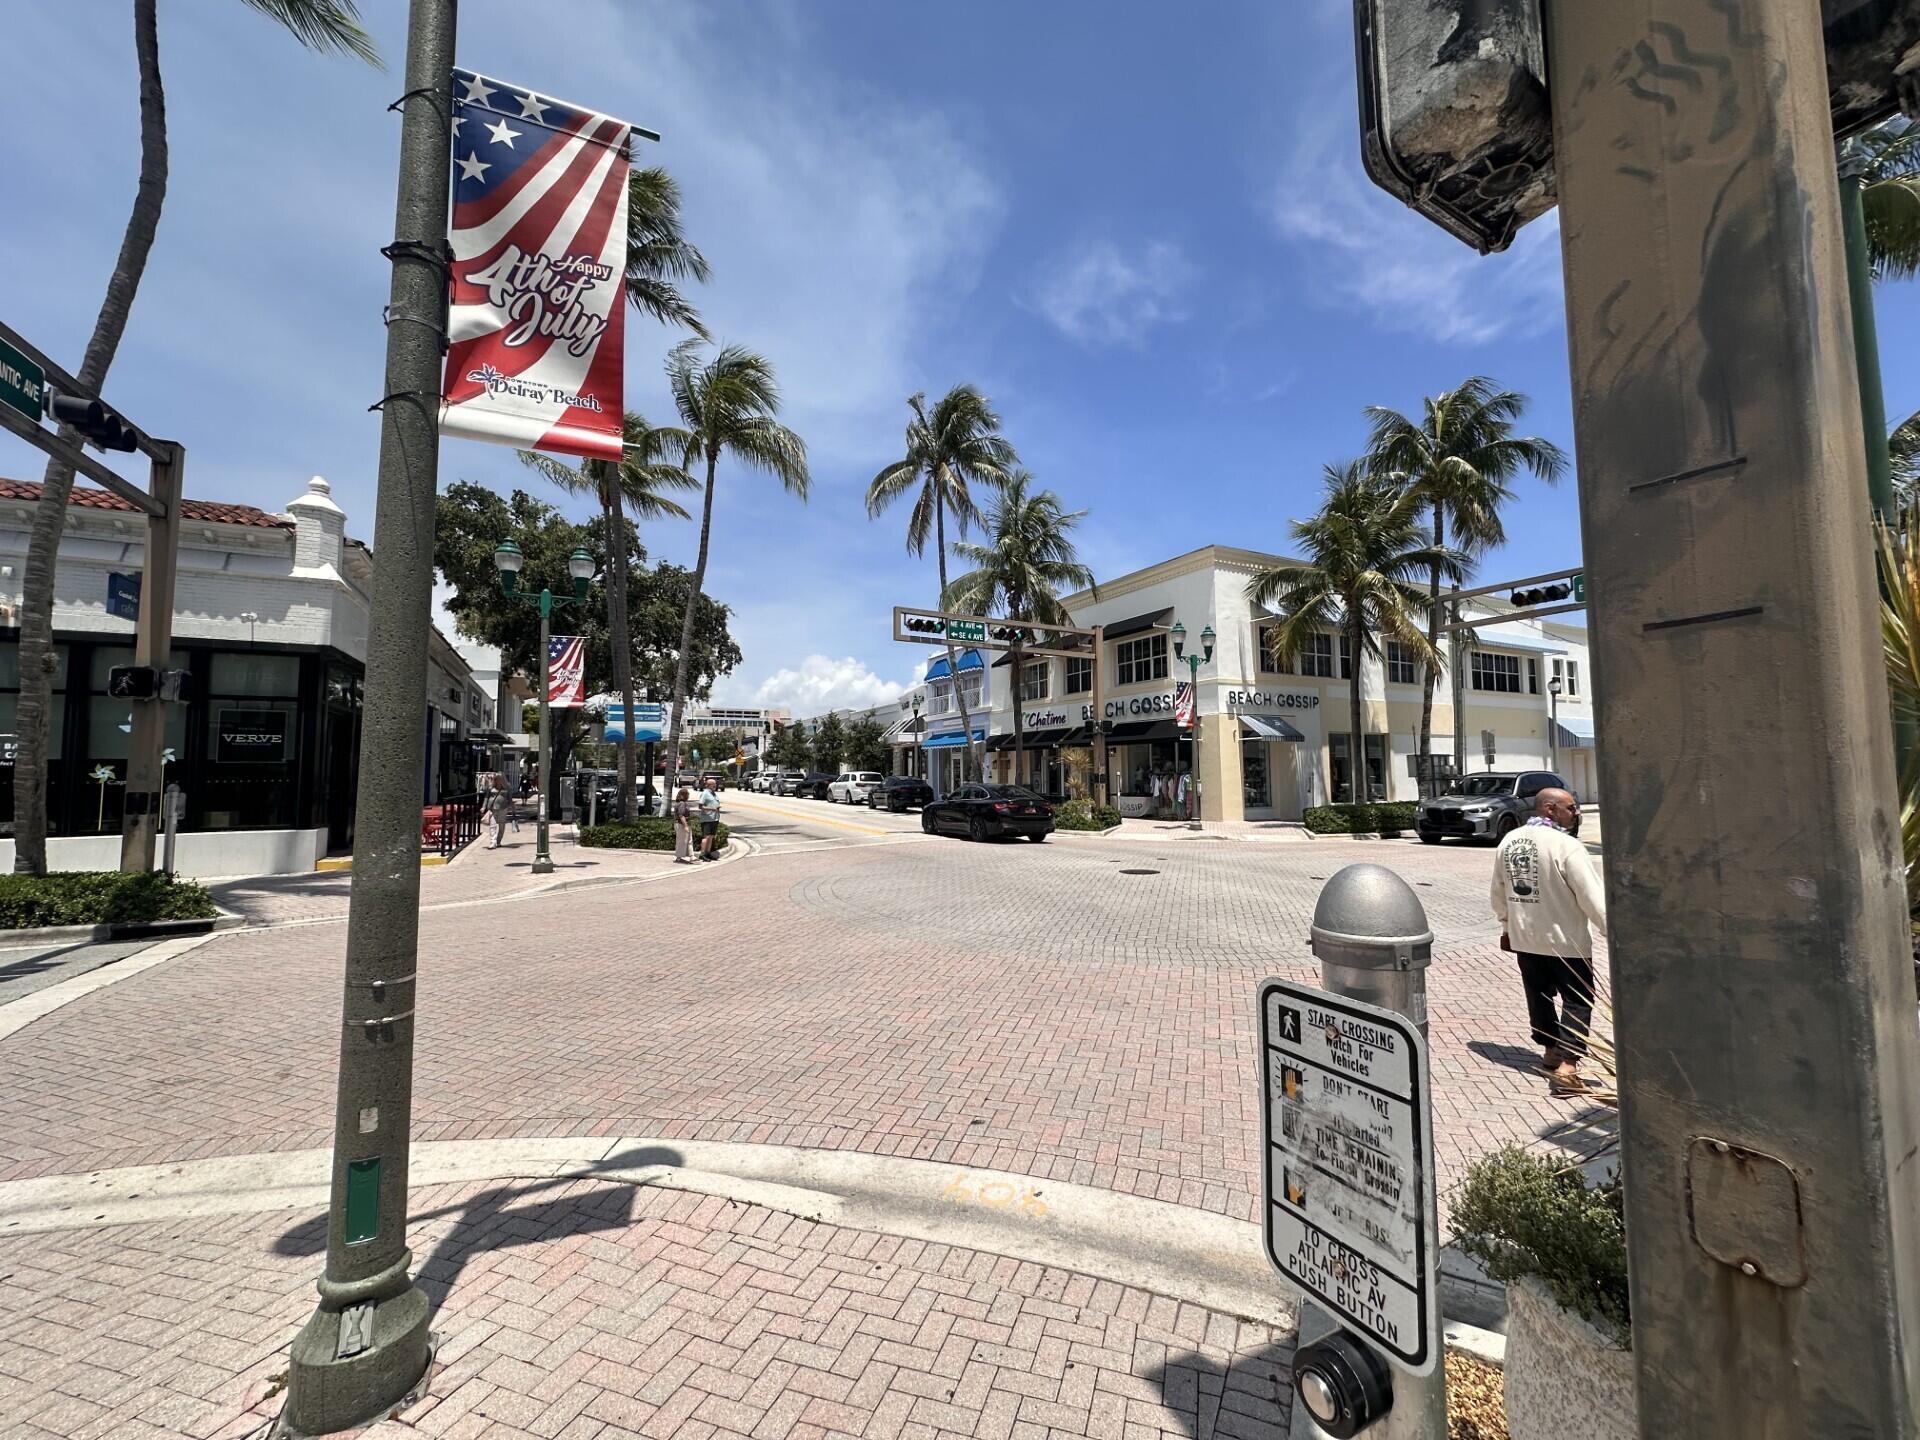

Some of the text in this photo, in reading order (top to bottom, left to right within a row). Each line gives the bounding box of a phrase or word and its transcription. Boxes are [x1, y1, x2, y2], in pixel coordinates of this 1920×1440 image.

[465, 244, 561, 306] 4th
[550, 255, 611, 278] Happy
[550, 276, 595, 313] of
[504, 291, 608, 353] July
[23, 379, 40, 402] AVE
[506, 377, 548, 388] DOWNTOWN
[488, 379, 602, 413] Delray Beach
[964, 622, 976, 630] AVE
[972, 633, 984, 641] AVE
[1082, 699, 1125, 720] BECH
[1229, 691, 1319, 709] BEACH GOSSIP
[1028, 710, 1066, 727] Chatime
[222, 733, 282, 743] VERVE
[1308, 1009, 1395, 1050] START CROSSING
[1331, 1049, 1369, 1077] Vehicles
[1359, 1043, 1373, 1062] For
[1316, 1127, 1338, 1150] TIME
[1304, 1224, 1379, 1287] TO CROSS
[1289, 1253, 1398, 1344] PUSH BUTTON
[1368, 1286, 1386, 1311] AV
